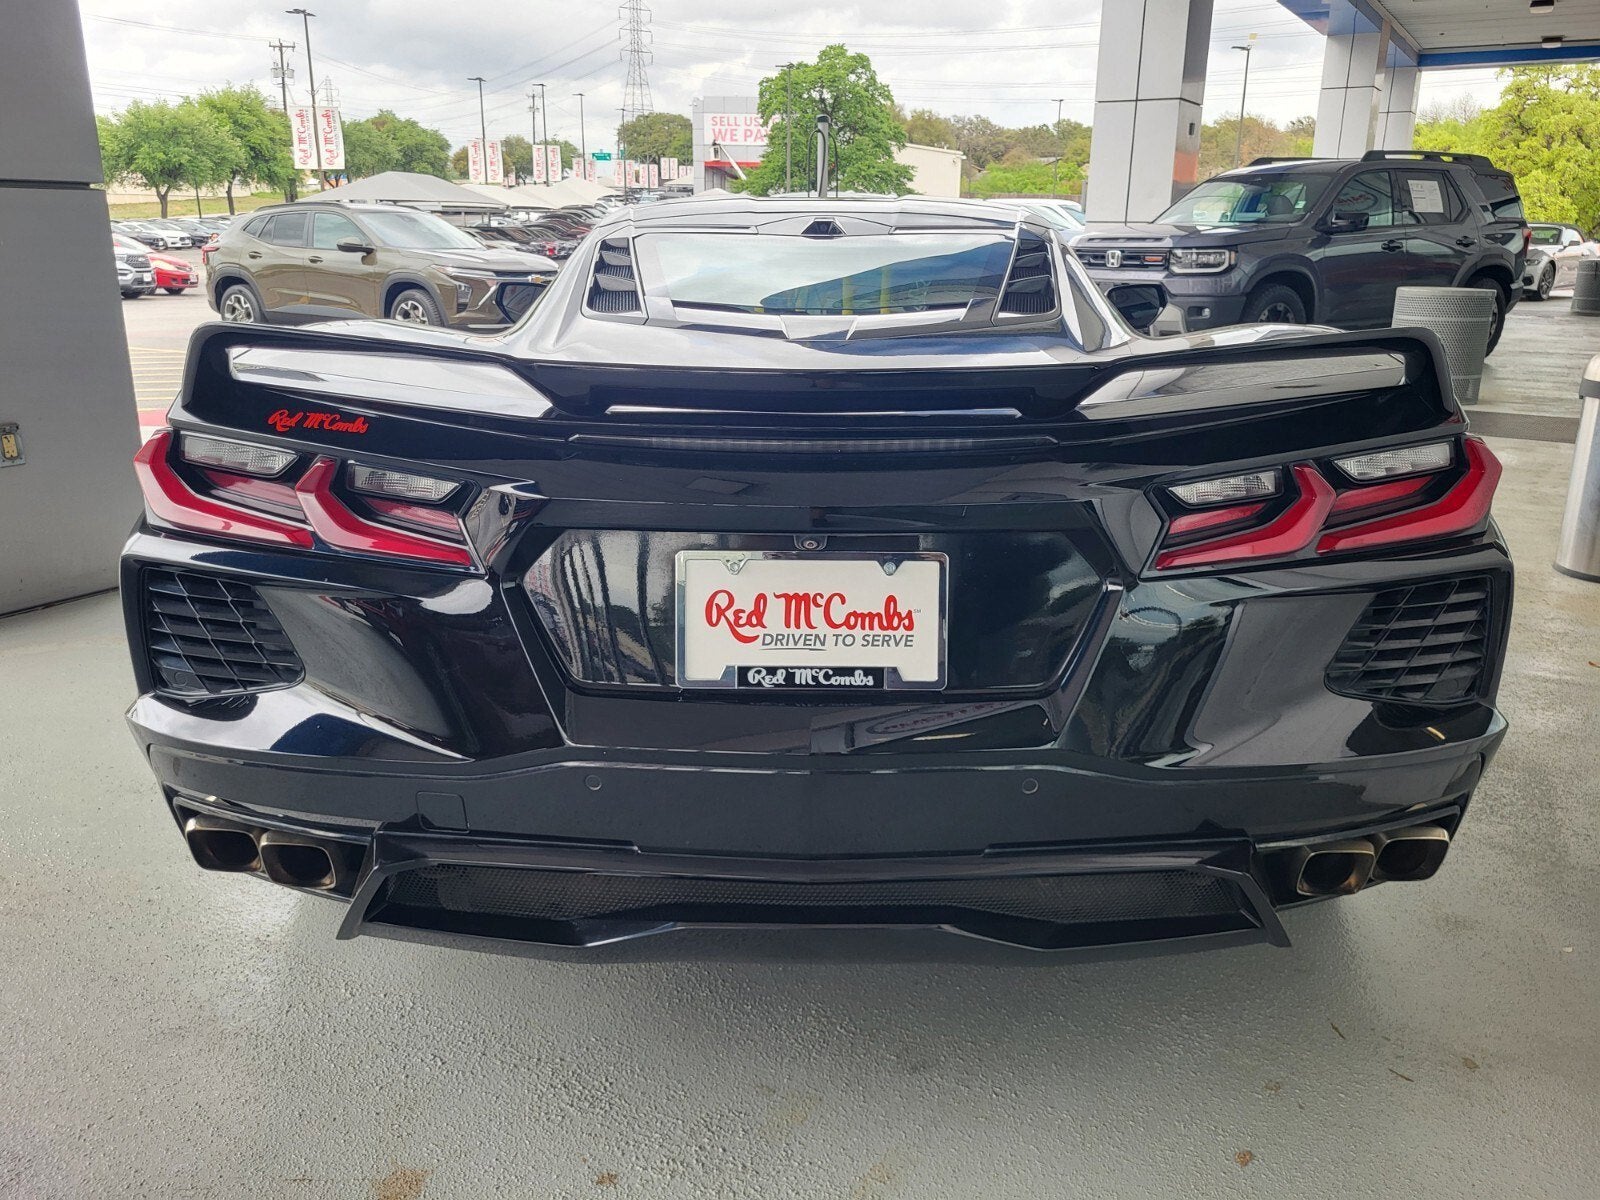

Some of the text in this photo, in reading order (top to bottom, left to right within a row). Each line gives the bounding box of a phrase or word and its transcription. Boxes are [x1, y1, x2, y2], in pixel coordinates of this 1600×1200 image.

[711, 116, 740, 127] SELL
[744, 116, 760, 127] US
[712, 128, 738, 142] WE
[268, 409, 369, 433] Red McCombs
[705, 589, 768, 644] Red
[773, 591, 915, 632] McCombs
[761, 633, 915, 648] DRIVEN TO SERVE
[747, 667, 874, 688] Red McCombs
